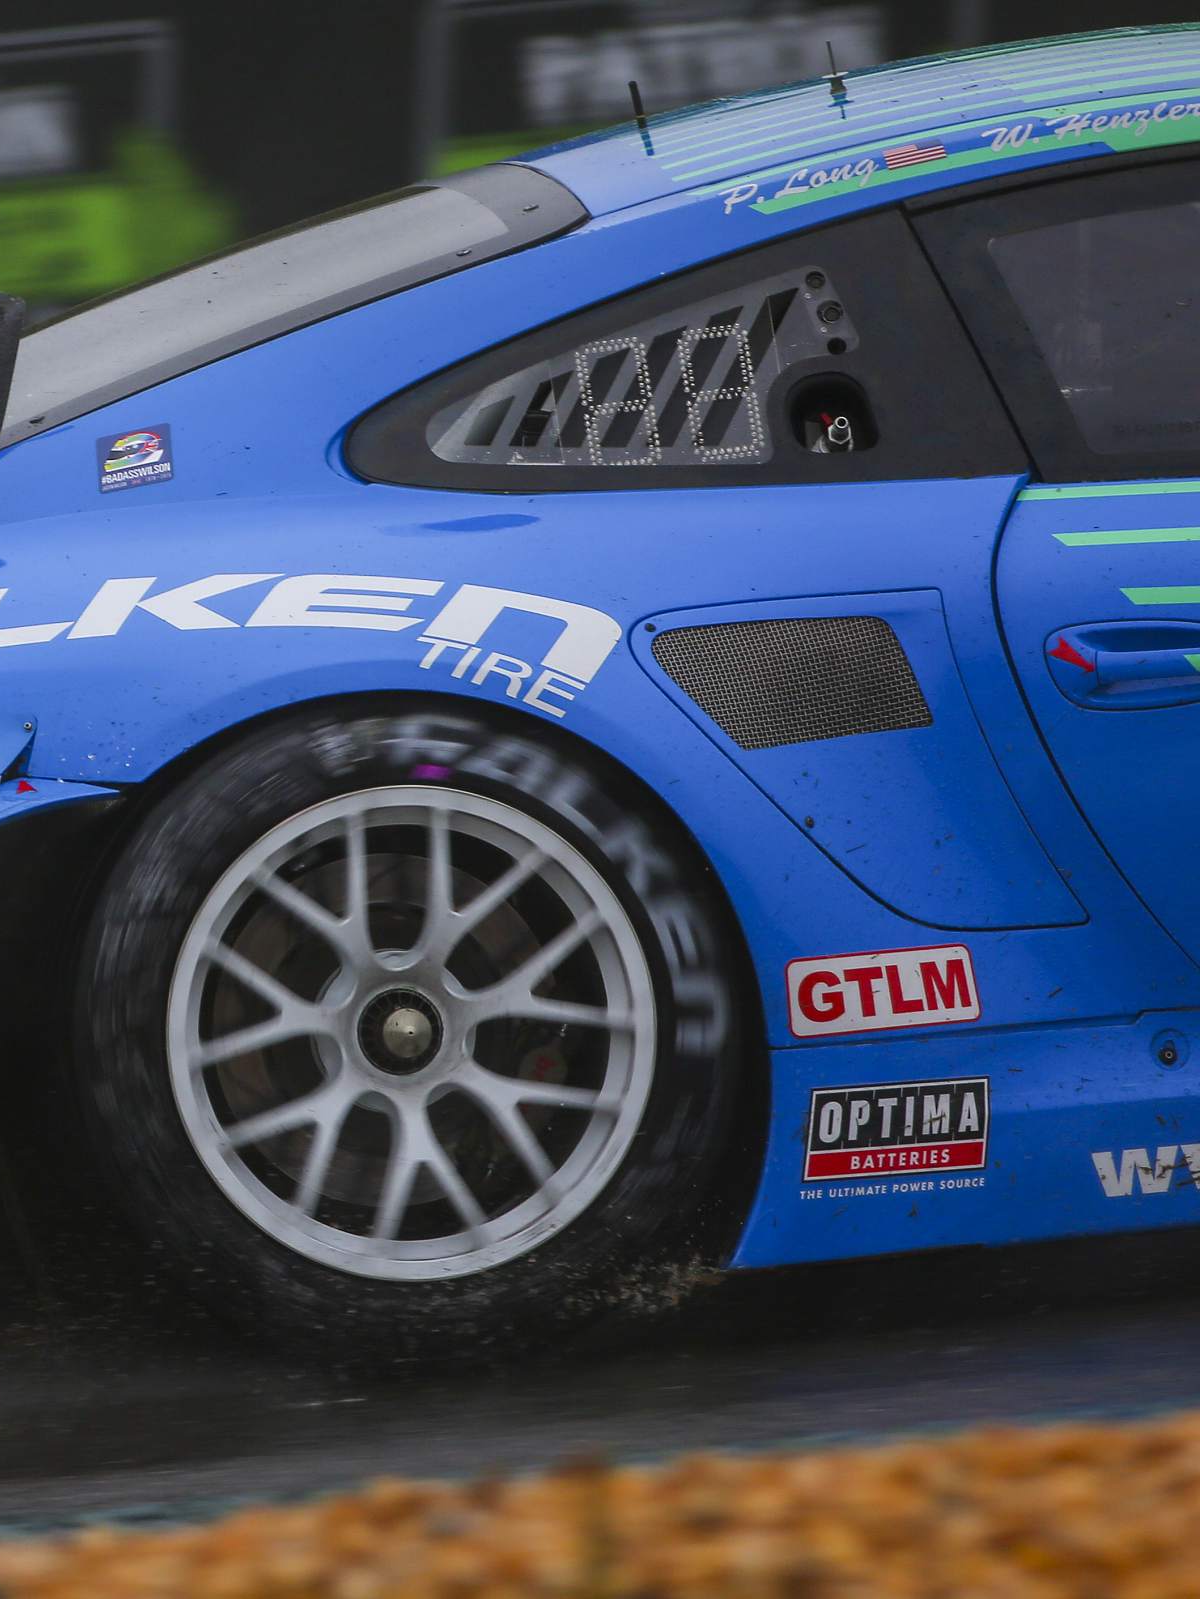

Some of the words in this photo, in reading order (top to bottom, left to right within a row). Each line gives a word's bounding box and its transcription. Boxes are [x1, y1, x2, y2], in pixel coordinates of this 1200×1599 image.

[980, 122, 1040, 153] W.
[1045, 101, 1200, 138] Henzler
[719, 183, 765, 215] P.
[775, 157, 880, 199] Long
[415, 635, 587, 719] TIRE
[798, 959, 972, 1023] GTLM
[818, 1091, 980, 1144] OPTIMA
[850, 1148, 951, 1170] BATTERIES
[800, 1190, 823, 1200] THE
[829, 1185, 887, 1199] ULTIMATE
[892, 1182, 934, 1193] POWER
[939, 1177, 985, 1190] SOURCE
